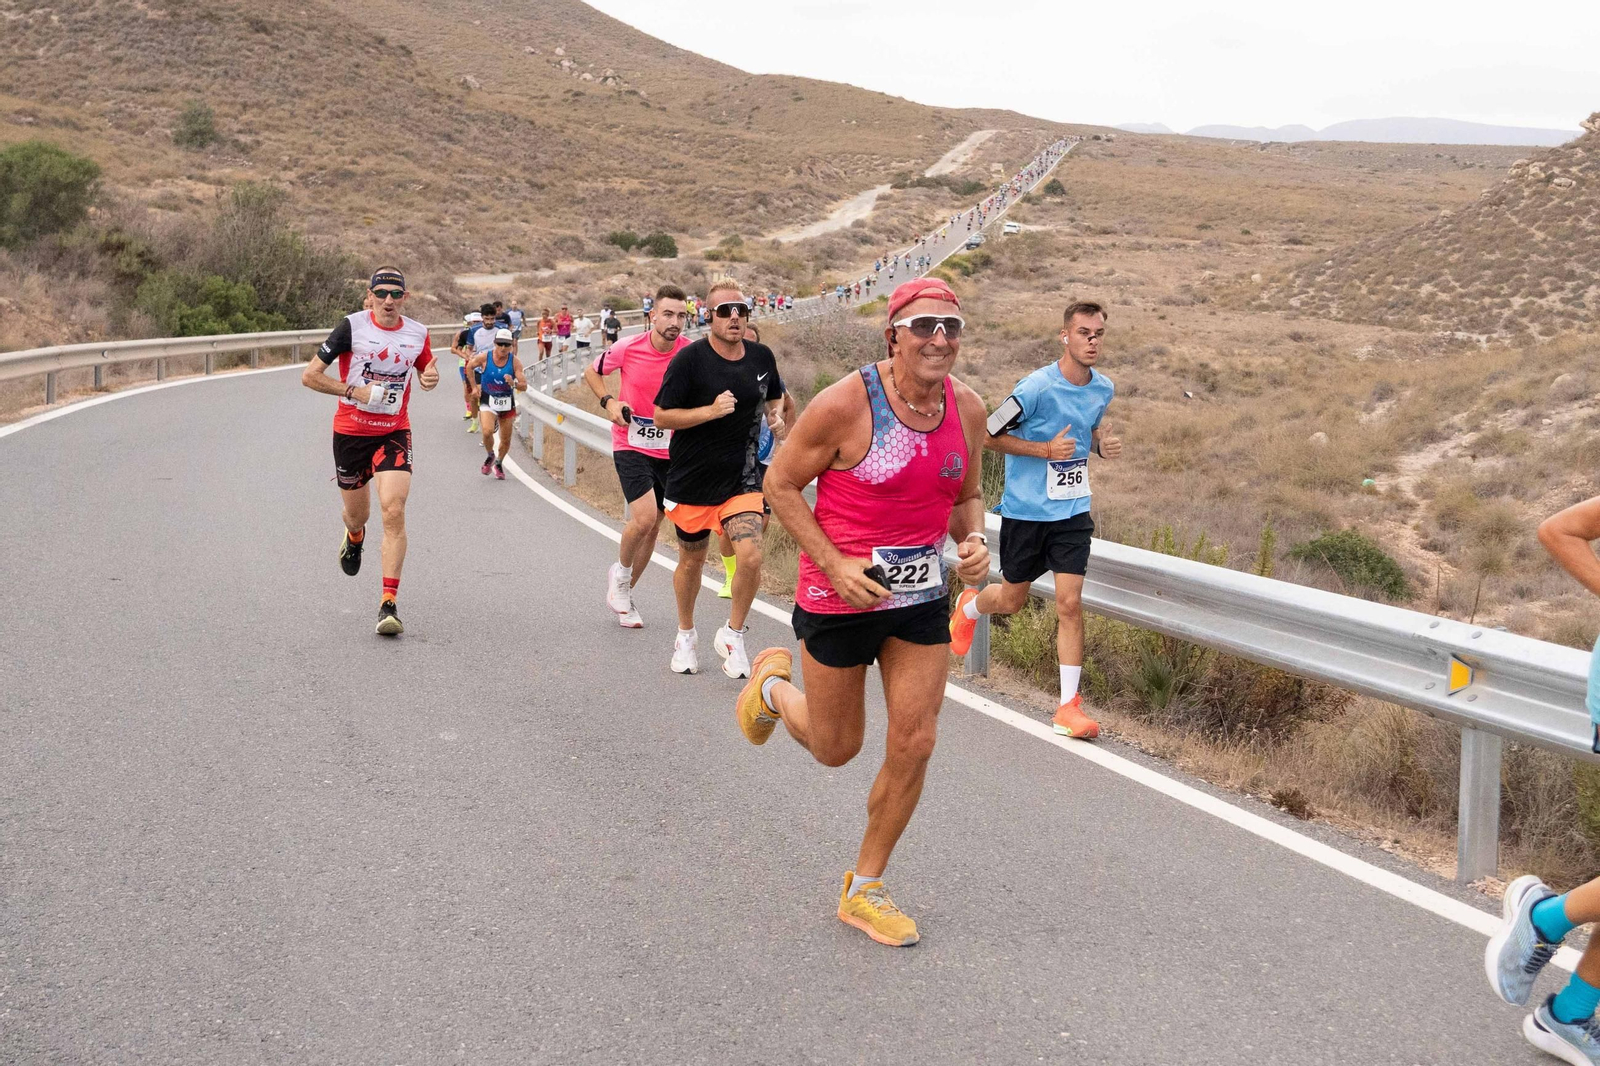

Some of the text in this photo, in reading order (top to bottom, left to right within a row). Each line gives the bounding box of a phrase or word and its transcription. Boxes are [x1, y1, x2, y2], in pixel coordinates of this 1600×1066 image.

[637, 427, 665, 438] 456
[1057, 470, 1083, 486] 256
[885, 552, 899, 563] 39
[887, 563, 930, 584] 222
